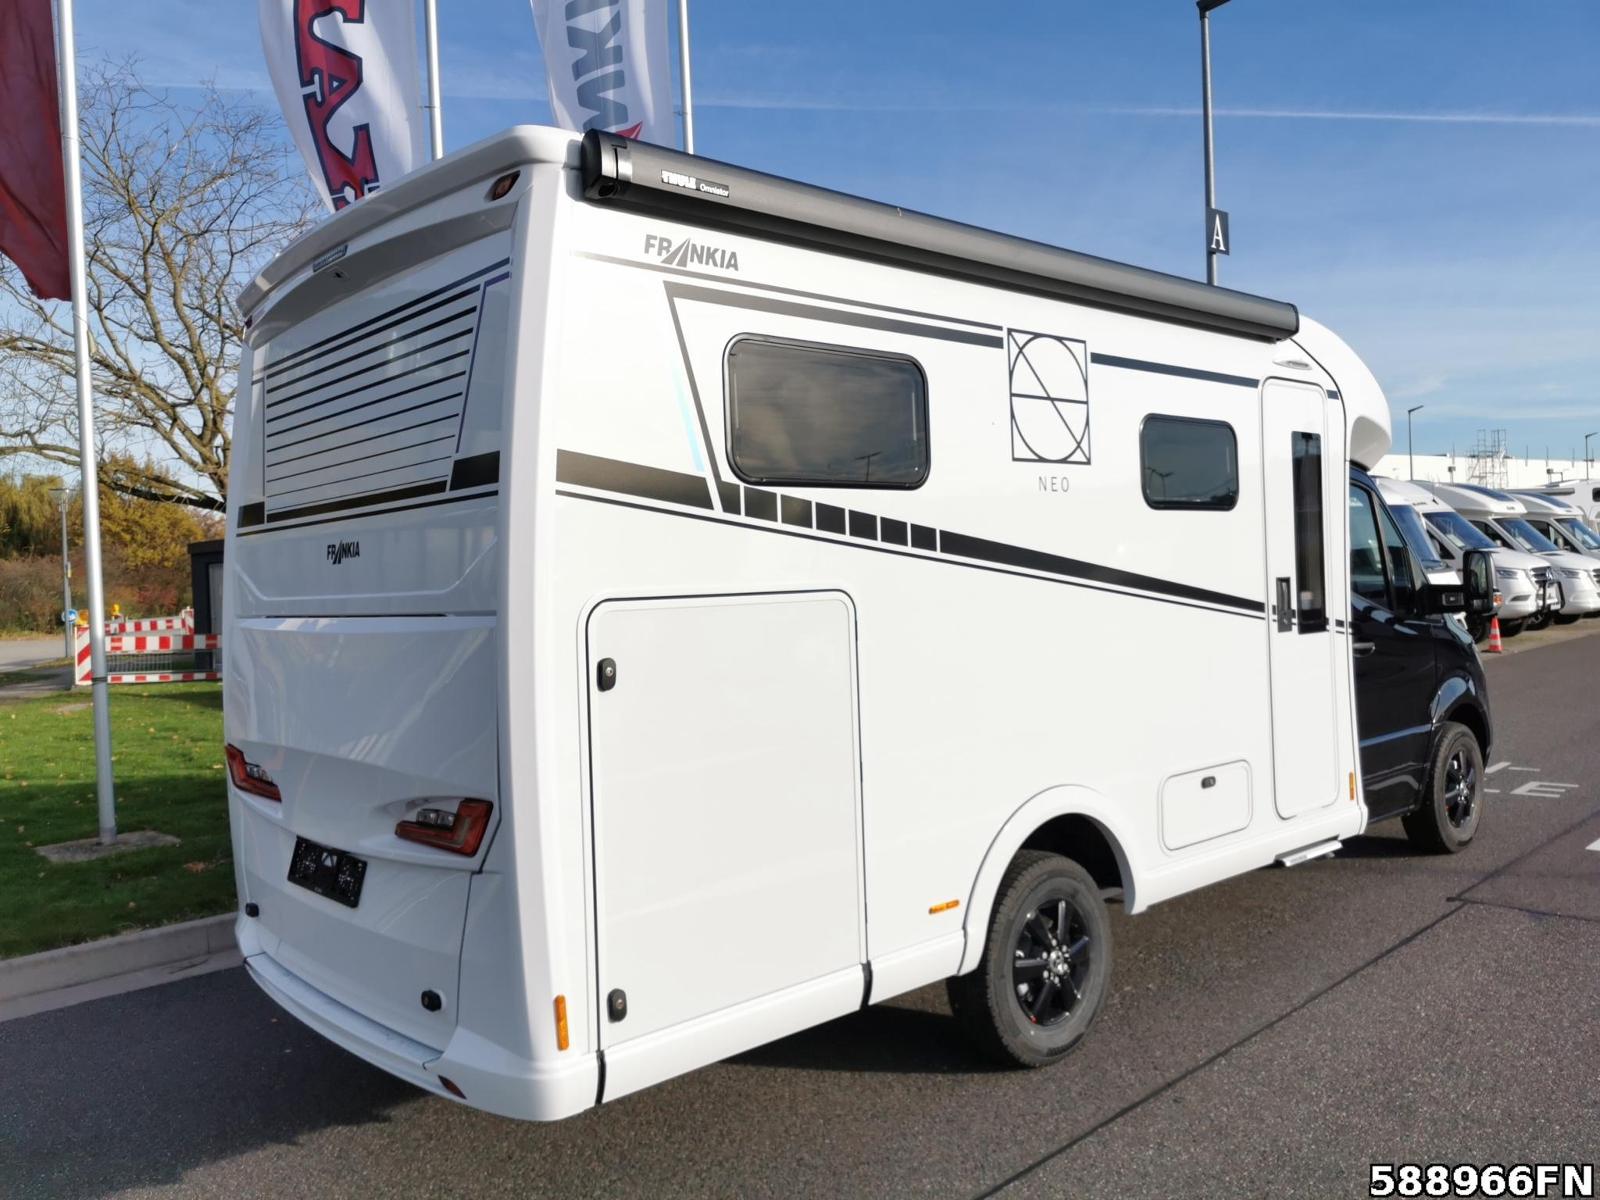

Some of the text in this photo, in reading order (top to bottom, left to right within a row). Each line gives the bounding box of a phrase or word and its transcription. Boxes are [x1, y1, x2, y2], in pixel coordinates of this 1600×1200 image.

[1211, 213, 1226, 251] A
[644, 234, 739, 271] FRANKIA
[1038, 476, 1070, 492] NEO
[327, 540, 360, 565] FRANKIA
